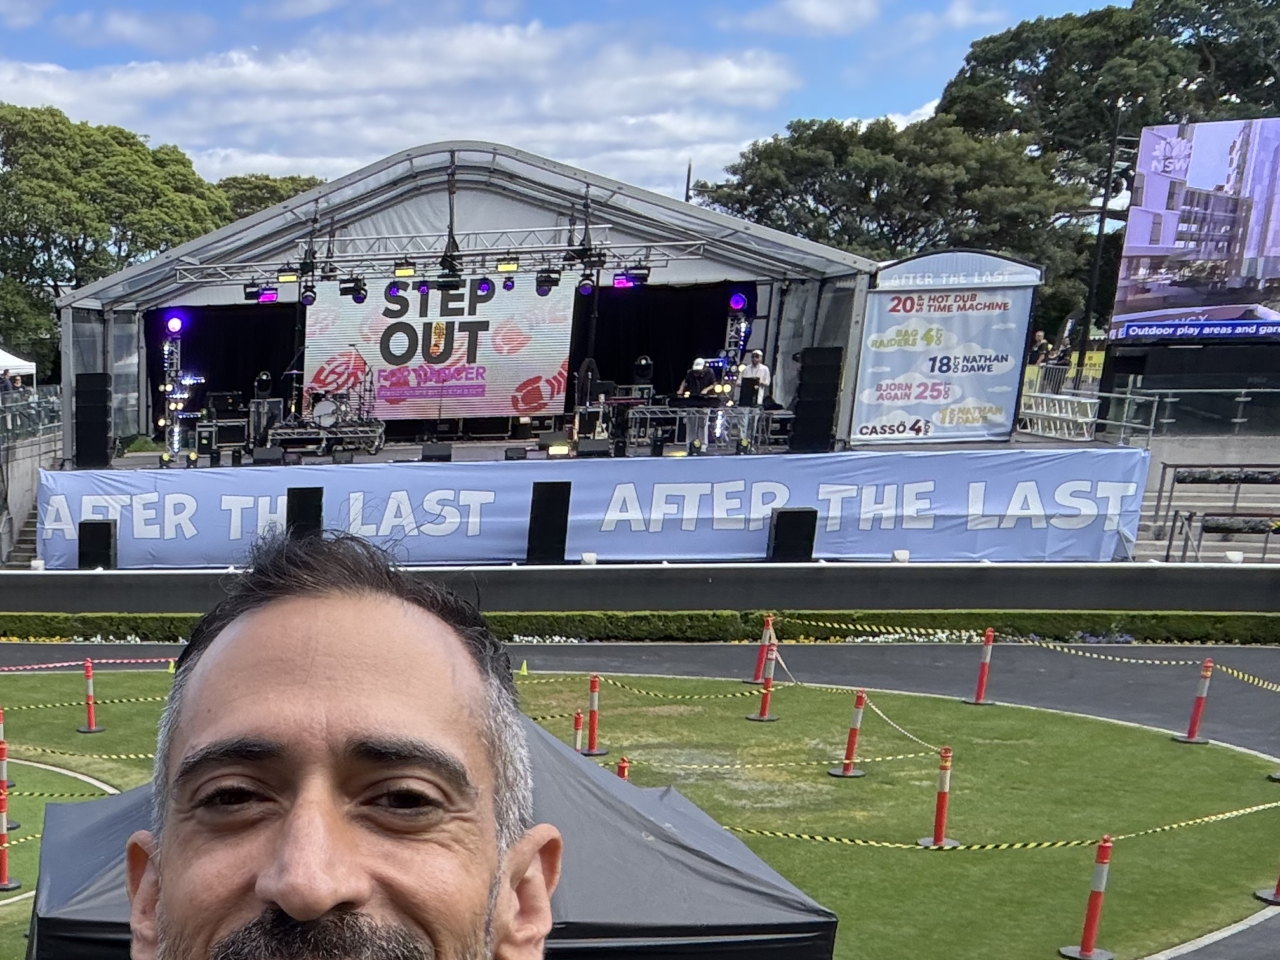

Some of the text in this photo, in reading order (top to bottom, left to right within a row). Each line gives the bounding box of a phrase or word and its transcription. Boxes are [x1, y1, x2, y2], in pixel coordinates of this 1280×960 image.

[1151, 158, 1190, 172] NSW
[941, 272, 968, 284] THE
[974, 270, 1011, 283] LAST
[382, 278, 495, 319] STEP
[888, 296, 915, 313] 20
[927, 293, 977, 304] HOT DUB
[927, 301, 1010, 313] TIME MACHINE
[895, 329, 919, 338] BAG
[921, 328, 935, 346] 4
[1129, 326, 1174, 336] Outdoor
[1176, 325, 1201, 336] play
[1202, 325, 1232, 334] areas
[1234, 324, 1257, 334] and
[379, 320, 490, 366] OUT
[871, 337, 918, 348] RAIDERS
[928, 355, 952, 373] 18
[962, 354, 1009, 363] NATHAN
[961, 364, 994, 373] DAWE
[875, 383, 913, 392] BJORN
[914, 382, 944, 400] 25
[876, 392, 912, 401] AGAIN
[909, 419, 923, 436] 4
[349, 489, 496, 537] LAST
[817, 480, 936, 532] THE
[966, 480, 1138, 532] LAST
